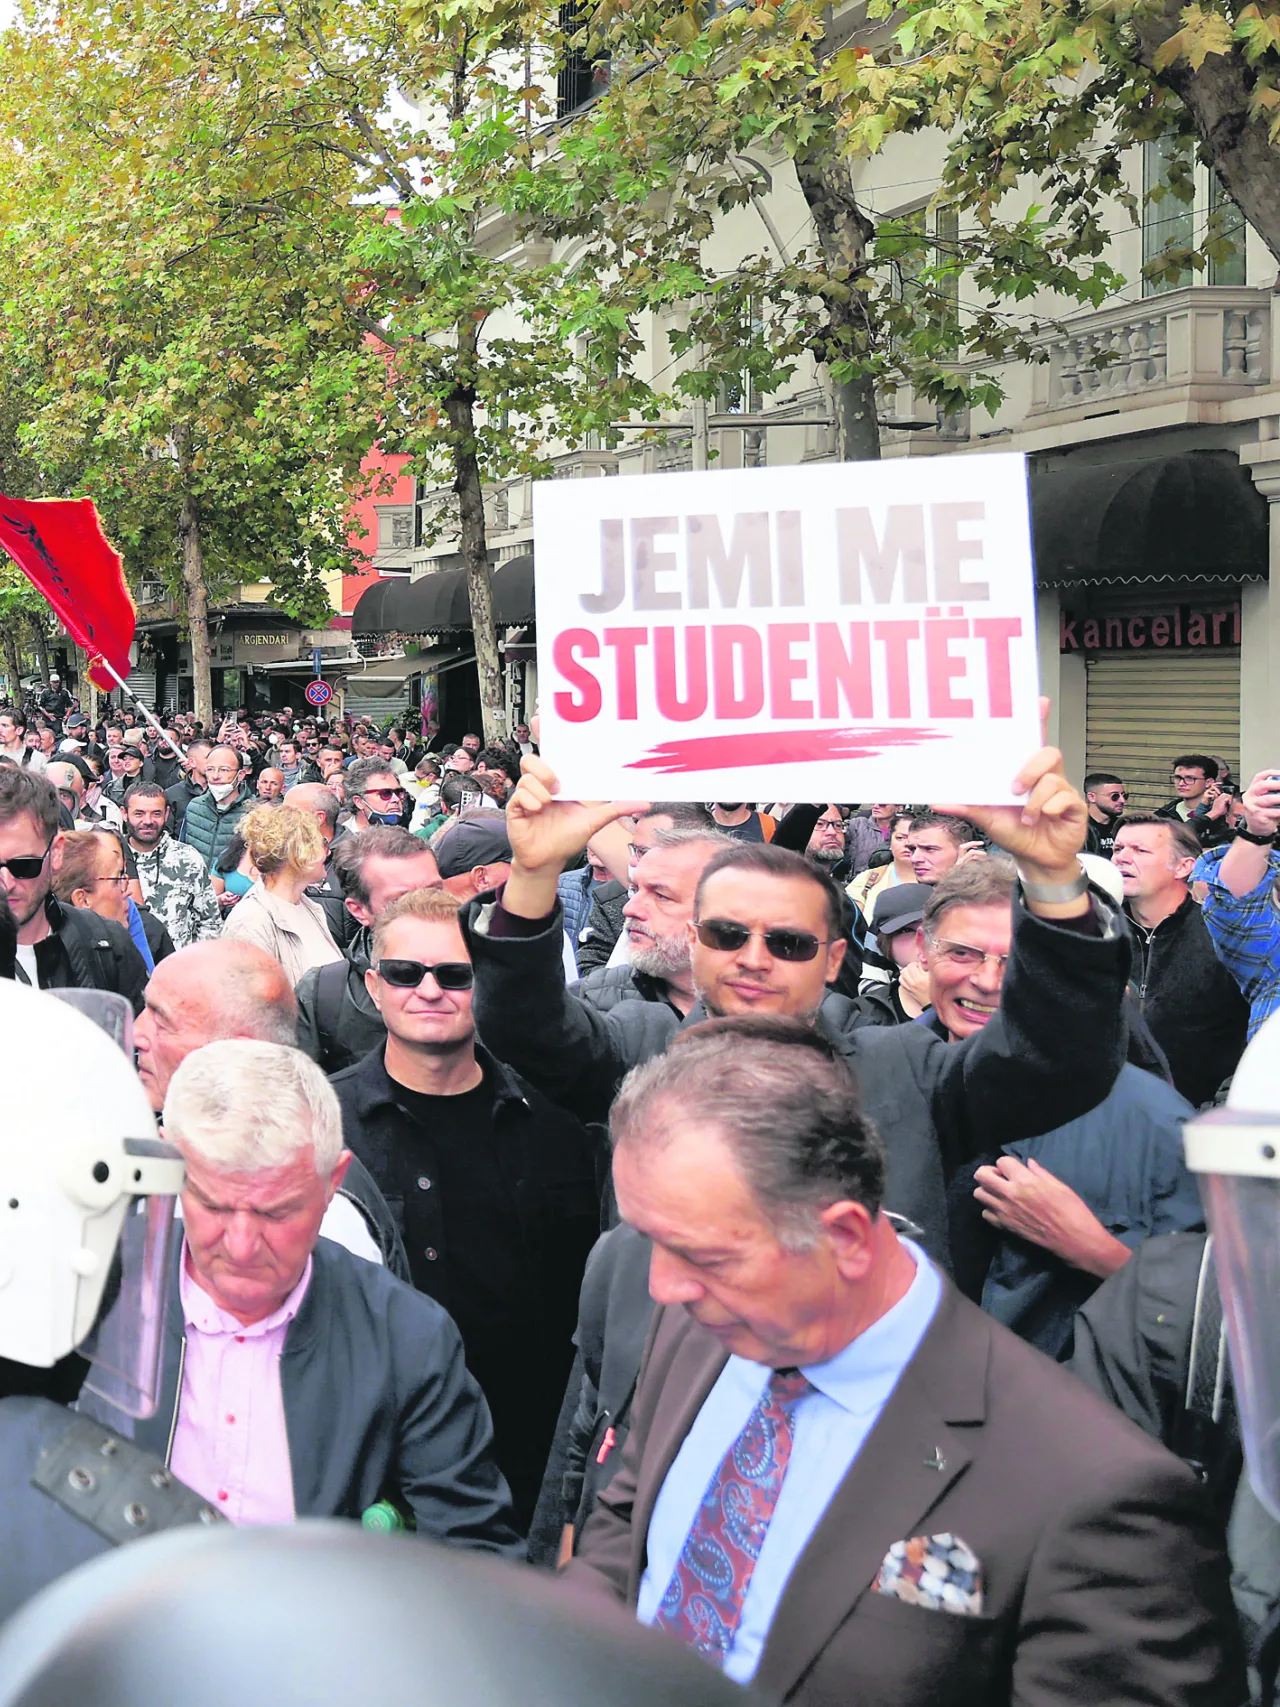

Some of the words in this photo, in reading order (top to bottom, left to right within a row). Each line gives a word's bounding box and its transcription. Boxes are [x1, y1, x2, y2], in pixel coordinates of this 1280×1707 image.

[578, 510, 803, 614] JEMI
[835, 501, 990, 605] ME
[239, 632, 289, 646] ARGJENDARI
[553, 606, 1022, 723] STUDENTËT
[1060, 602, 1241, 649] kancelari
